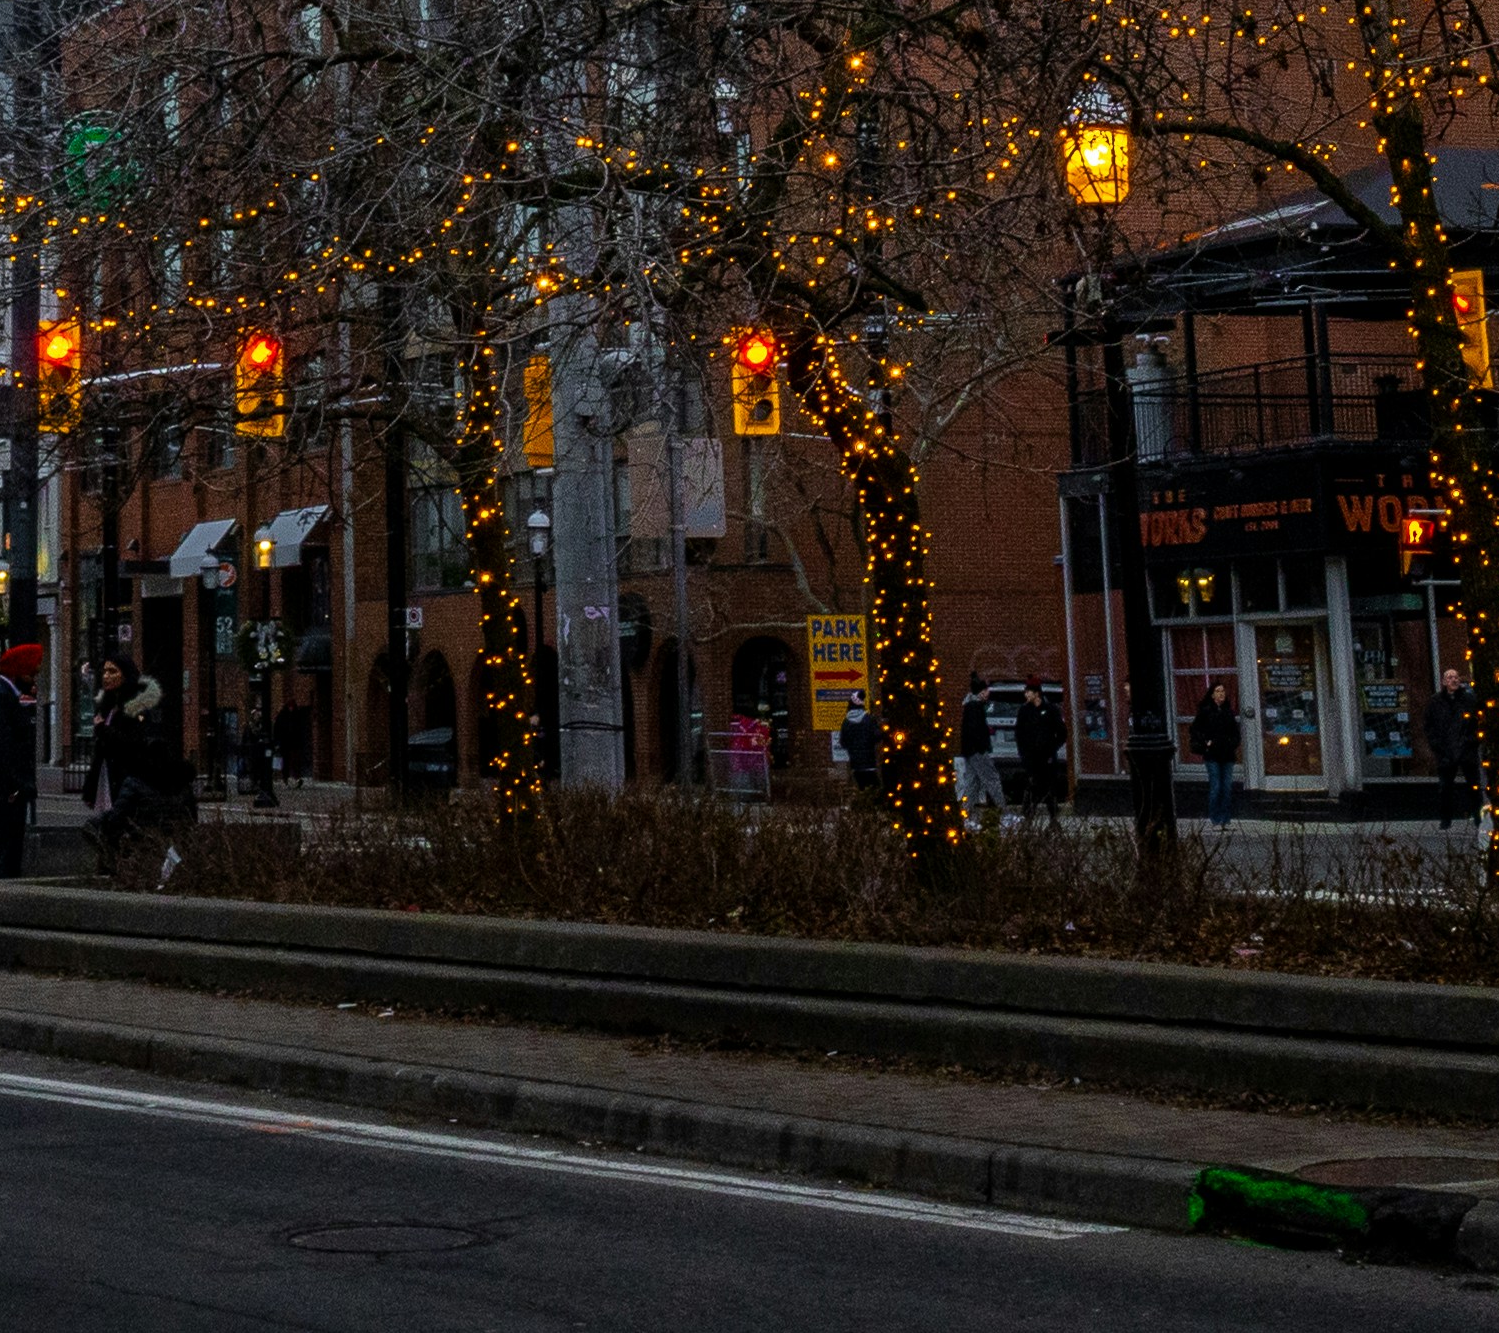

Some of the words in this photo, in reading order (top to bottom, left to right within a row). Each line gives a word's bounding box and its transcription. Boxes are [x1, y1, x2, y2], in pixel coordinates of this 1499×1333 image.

[215, 616, 234, 633] 52
[812, 619, 861, 637] PARK
[813, 643, 863, 662] HERE
